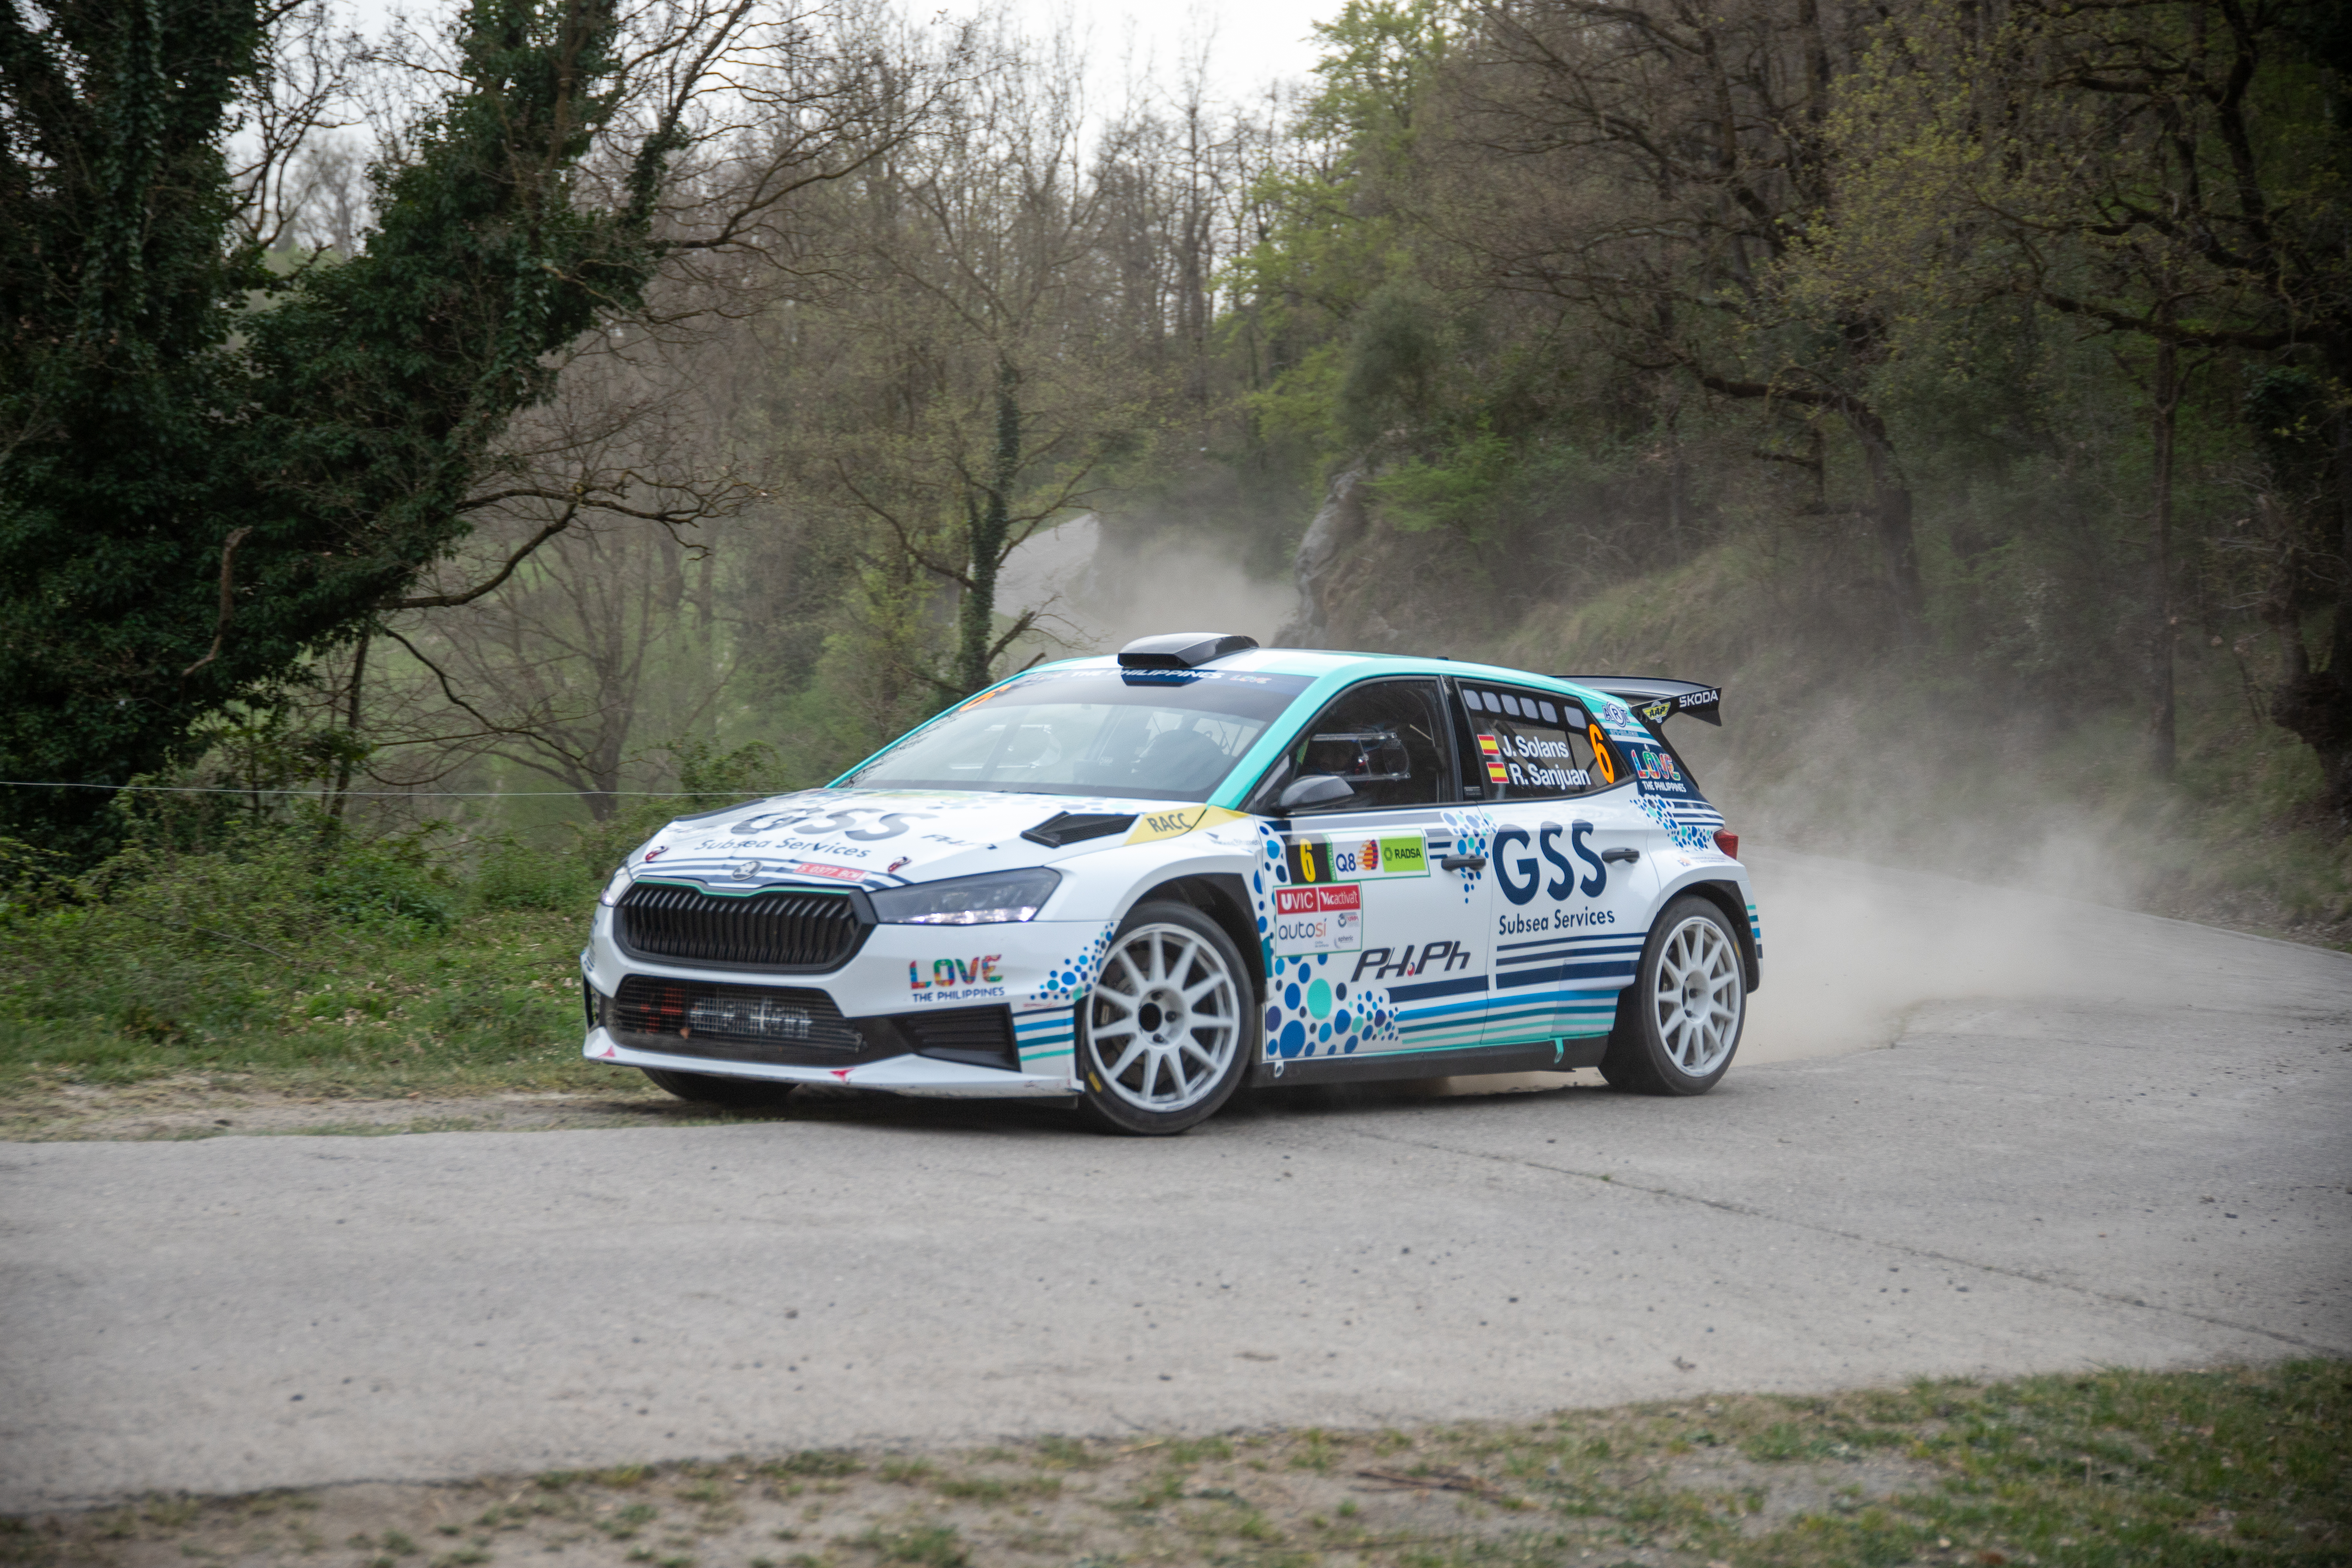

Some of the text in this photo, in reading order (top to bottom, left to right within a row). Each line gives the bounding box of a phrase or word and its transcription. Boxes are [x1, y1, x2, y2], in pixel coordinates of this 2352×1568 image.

[1107, 669, 1225, 679] PHILIPPINES
[1503, 735, 1569, 758] J. Solans
[1589, 724, 1614, 783] 6
[1509, 763, 1591, 790] R. Sanjuan
[1631, 749, 1681, 781] LOVE
[1642, 781, 1687, 793] THE PHILIPPINES
[731, 806, 939, 841] GSS
[1147, 813, 1192, 833] RACC
[694, 838, 871, 858] Subsea Services
[1395, 848, 1422, 859] RADSA
[810, 866, 839, 875] 0377
[1299, 838, 1316, 882] 6
[1336, 853, 1357, 873] Q8
[1492, 819, 1607, 905] GSS
[1281, 891, 1314, 910] UVIC
[1279, 917, 1327, 940] autosí
[1499, 906, 1615, 935] Subsea Services
[910, 954, 1003, 990] LOVE
[912, 987, 1005, 1003] THE PHILIPPINES
